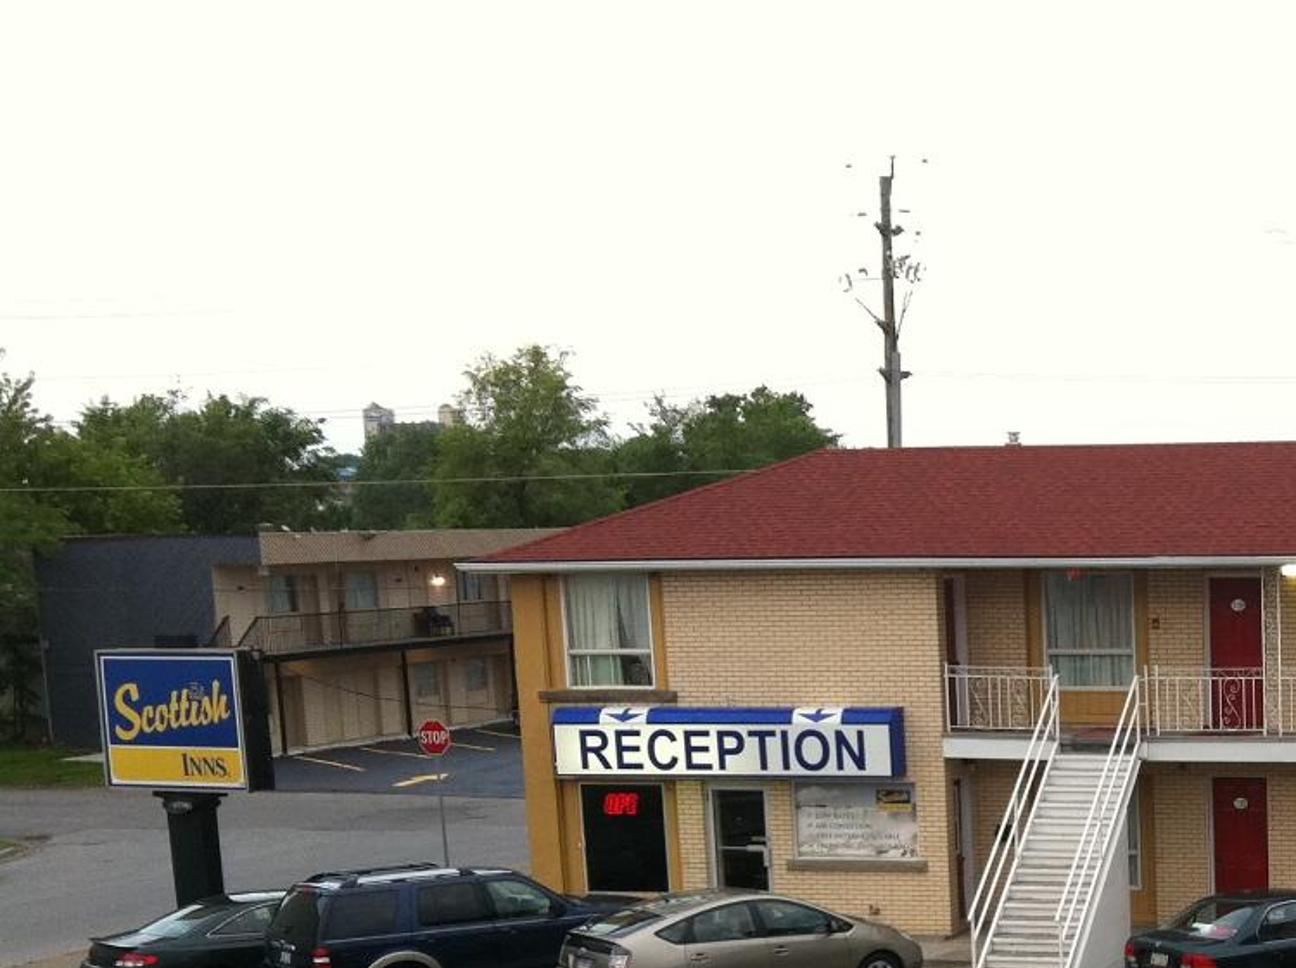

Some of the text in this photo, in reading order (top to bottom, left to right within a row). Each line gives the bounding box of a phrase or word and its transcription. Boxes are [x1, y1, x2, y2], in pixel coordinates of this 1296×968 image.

[113, 678, 231, 741] Scottish
[421, 730, 449, 744] STOP
[578, 729, 867, 772] RECEPTION
